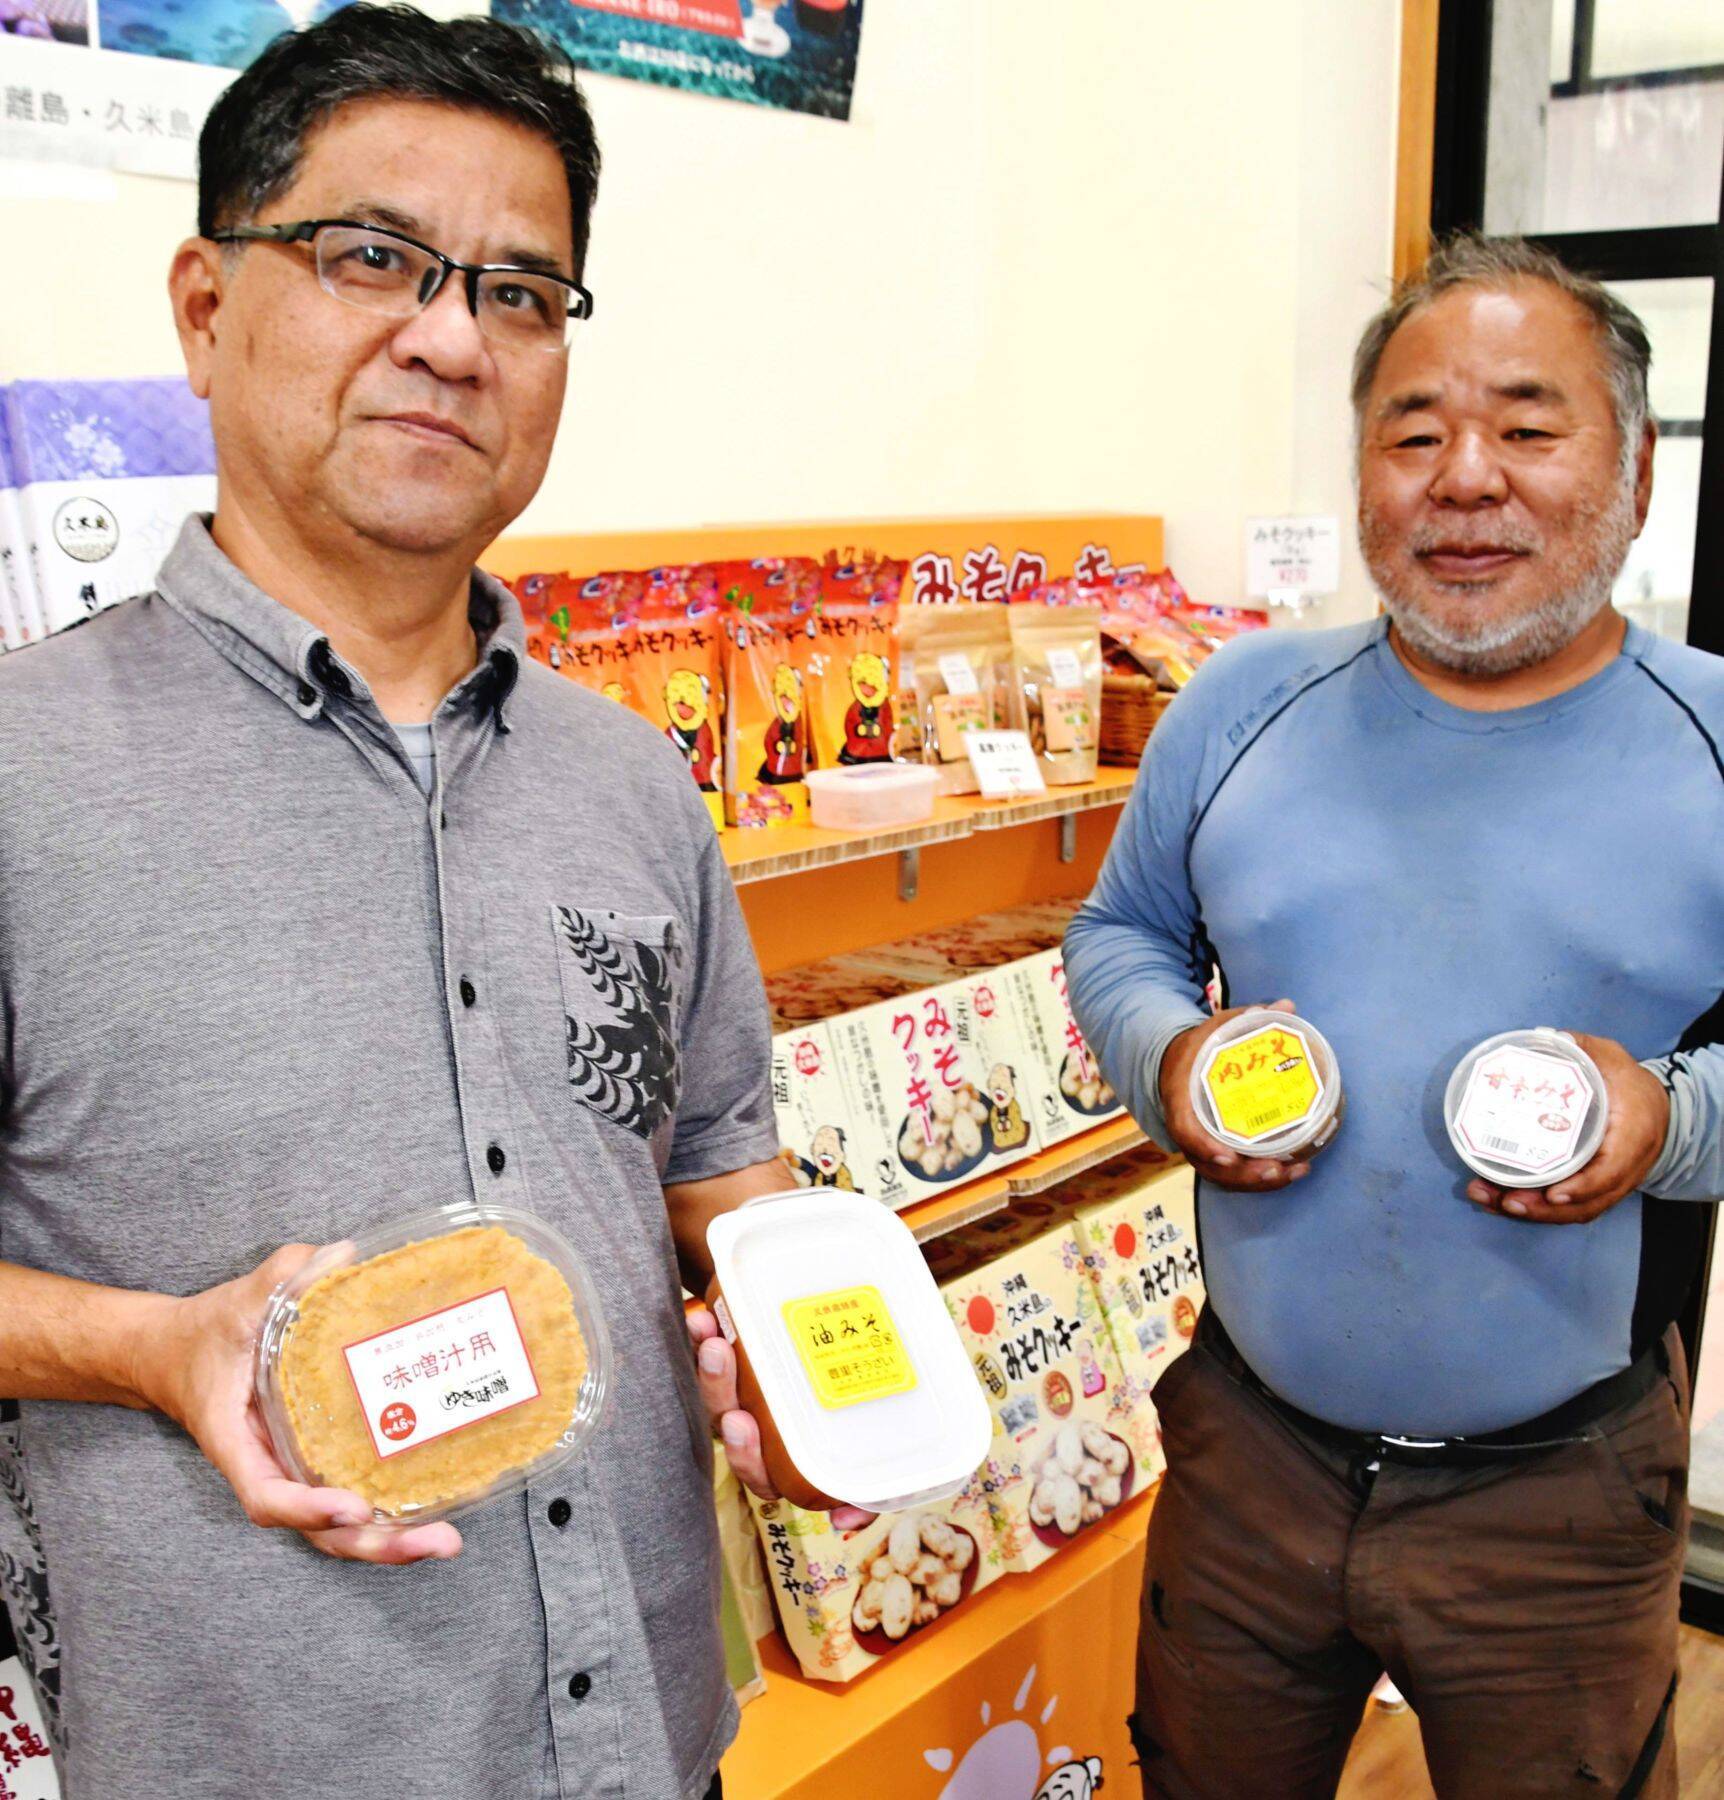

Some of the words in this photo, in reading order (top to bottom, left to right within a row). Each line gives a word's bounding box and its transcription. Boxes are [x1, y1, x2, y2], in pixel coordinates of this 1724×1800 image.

[892, 1013, 934, 1147] クッキー
[924, 997, 962, 1088] みそ
[382, 1331, 497, 1391] 味噌汁用
[810, 1314, 880, 1347] 油みそ
[1000, 1315, 1081, 1381] みそクッキー
[767, 1523, 801, 1607] みそクッキー
